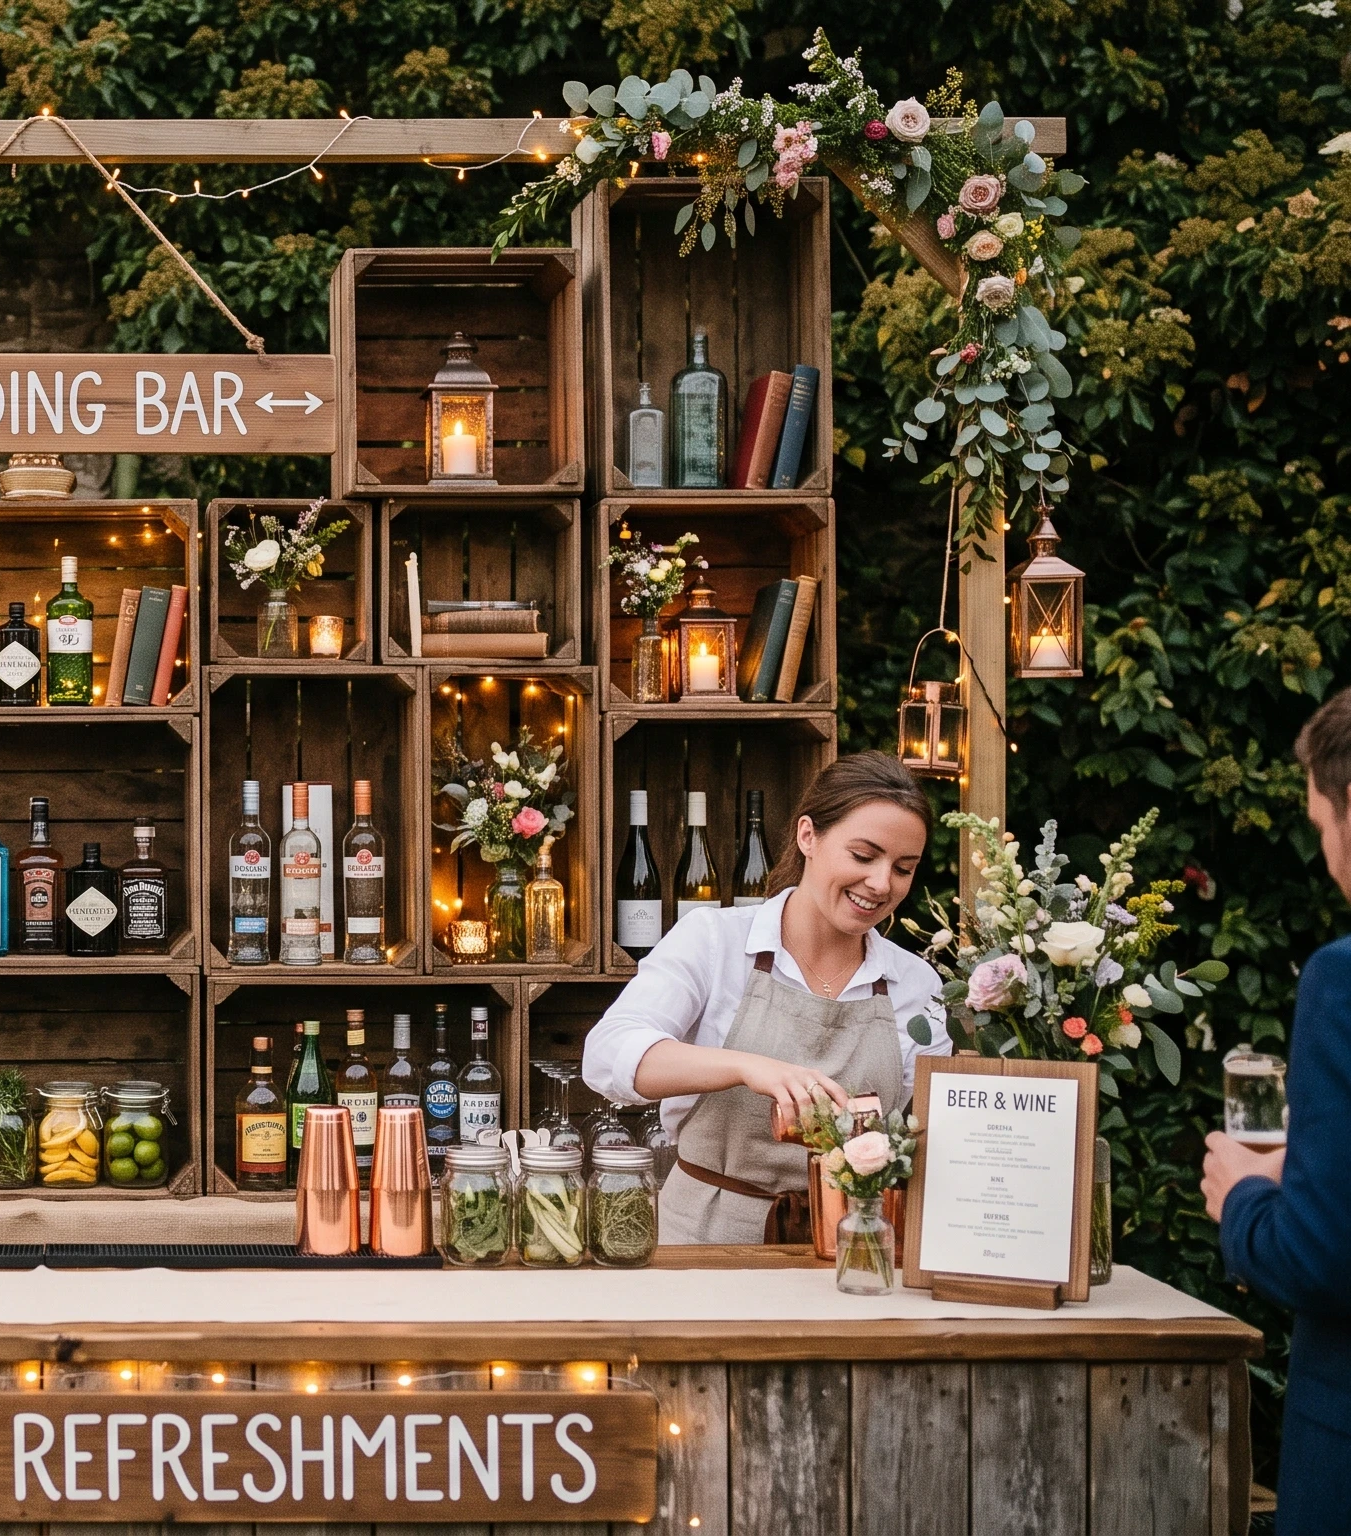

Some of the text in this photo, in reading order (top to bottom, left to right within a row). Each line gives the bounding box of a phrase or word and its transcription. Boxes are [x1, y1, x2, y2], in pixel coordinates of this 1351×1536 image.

[135, 370, 248, 436] BAR
[947, 1089, 1057, 1113] BEER & WINE
[13, 1412, 597, 1504] REFRESHMENTS
